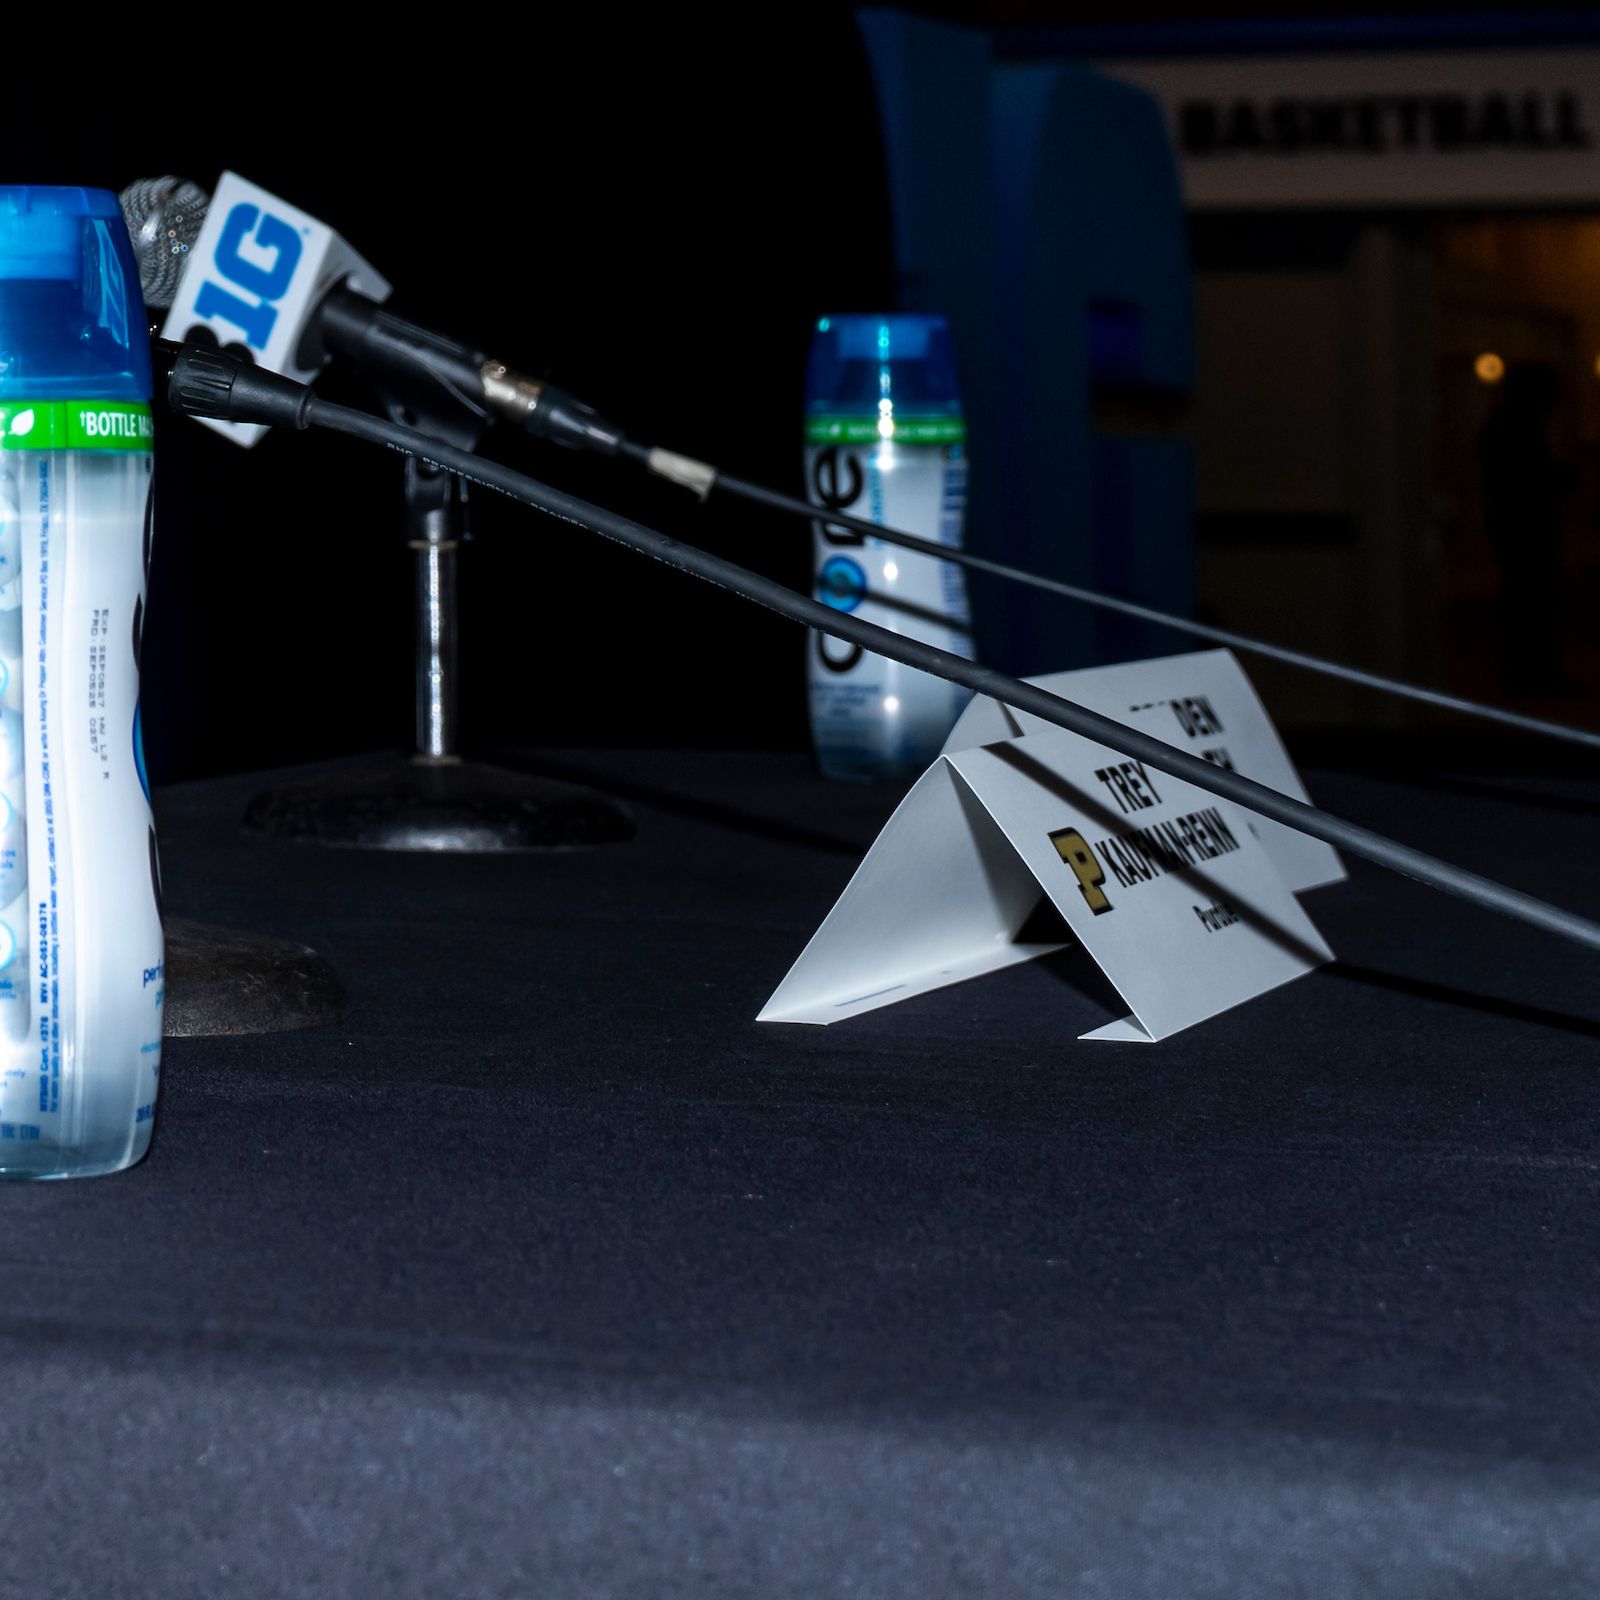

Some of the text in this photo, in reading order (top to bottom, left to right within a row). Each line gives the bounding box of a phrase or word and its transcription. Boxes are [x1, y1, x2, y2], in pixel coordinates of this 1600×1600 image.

[1183, 93, 1590, 154] BASKETBALL
[40, 504, 49, 513] TX
[40, 515, 49, 538] Frisco,
[39, 561, 48, 573] Box
[39, 575, 47, 584] PO
[39, 586, 47, 611] Service
[39, 613, 47, 646] Customer
[38, 648, 46, 663] Attn:
[38, 664, 47, 689] Pepper
[39, 700, 48, 722] Keurig
[89, 717, 99, 753] 0257
[42, 761, 51, 797] DRK-CORE
[1095, 760, 1162, 814] TREY
[47, 837, 56, 862] contact
[1095, 806, 1241, 888] KAUFMAN-RENN
[48, 864, 57, 887] report,
[1192, 904, 1241, 933] Purdue
[39, 1046, 49, 1072] Cert.
